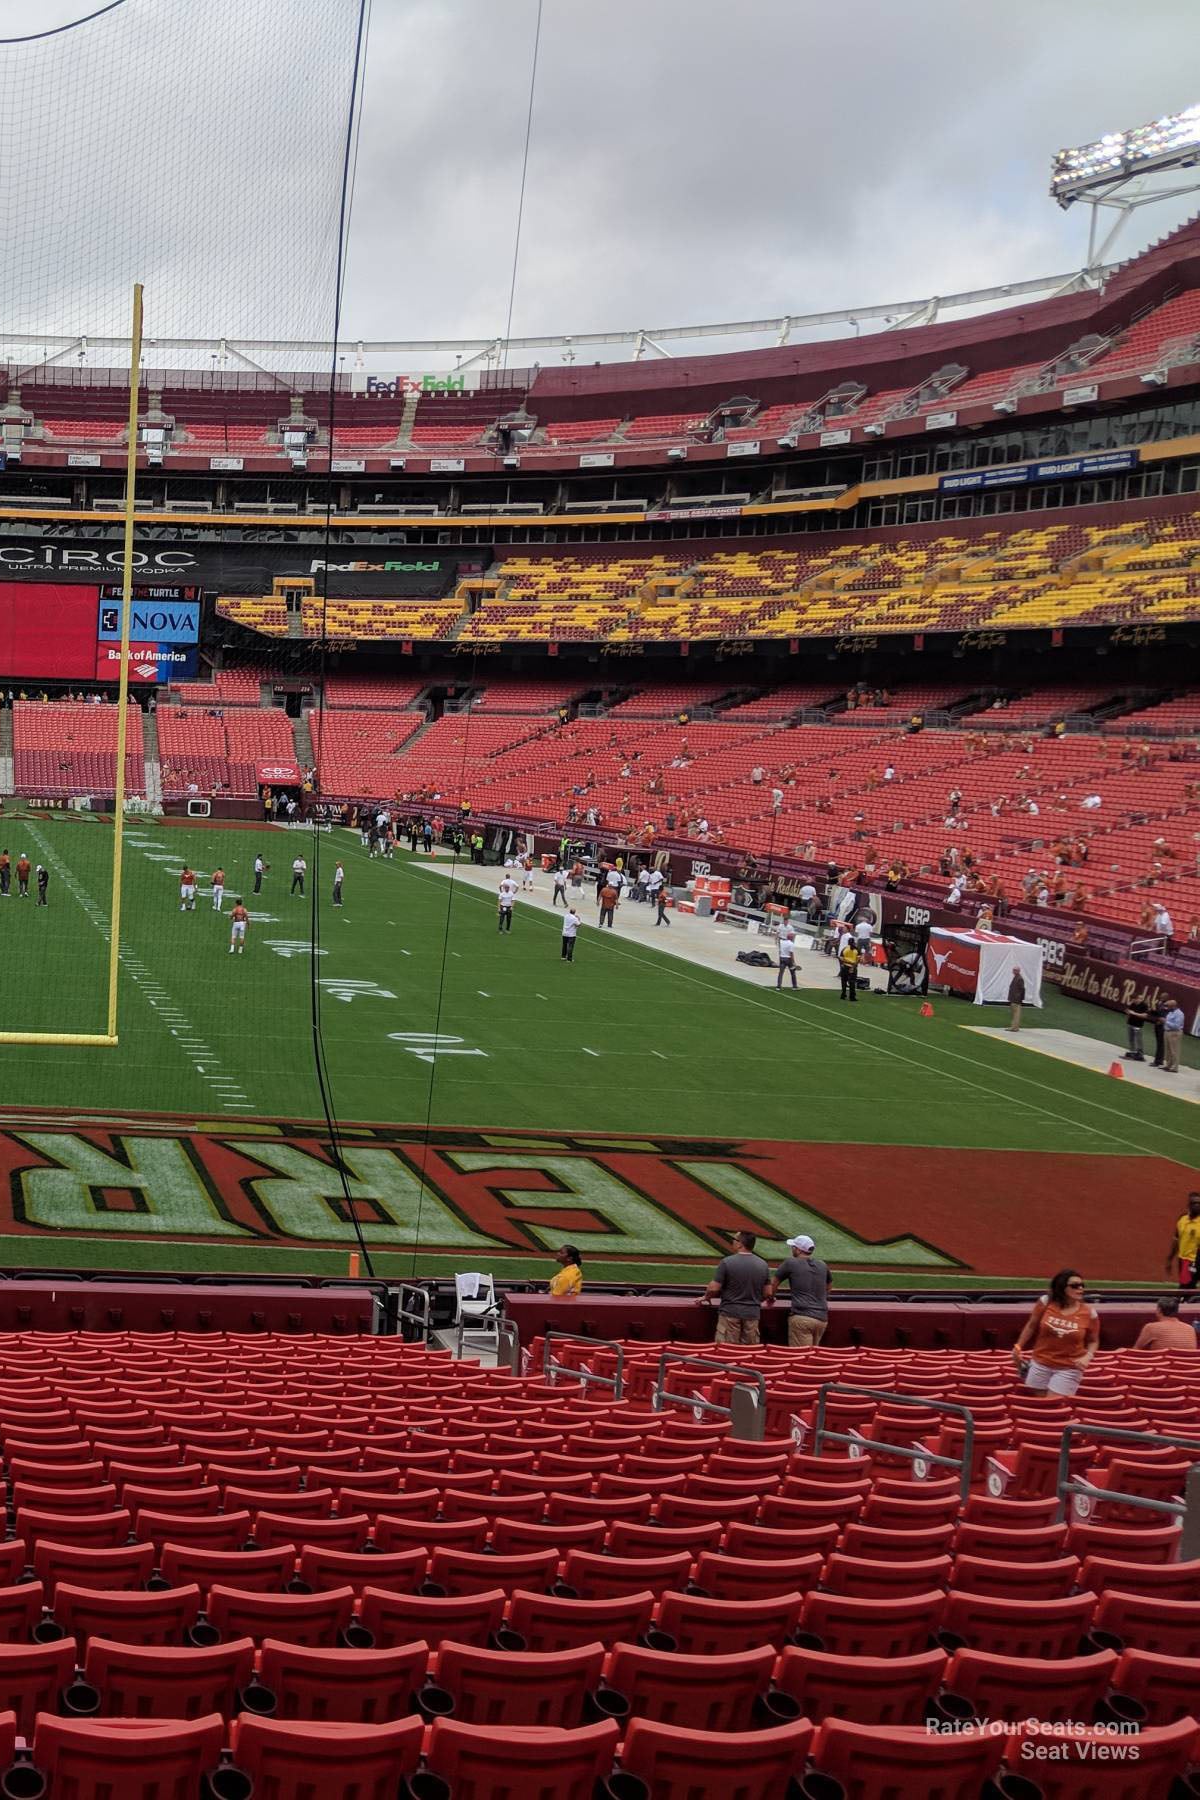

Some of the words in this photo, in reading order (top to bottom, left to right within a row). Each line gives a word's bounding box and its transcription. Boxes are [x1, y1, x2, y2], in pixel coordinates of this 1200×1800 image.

[367, 375, 464, 393] FedExField
[1058, 463, 1081, 474] LIGHT
[310, 560, 440, 573] FedExField
[133, 612, 195, 632] NOVA
[108, 650, 135, 660] Bak
[135, 651, 146, 660] of
[147, 651, 187, 661] America
[691, 860, 711, 875] 1972
[905, 906, 930, 926] 1982
[1061, 962, 1090, 991] Hail
[1087, 973, 1100, 994] to
[1101, 975, 1119, 1001] the
[1048, 1316, 1079, 1330] TEXAS
